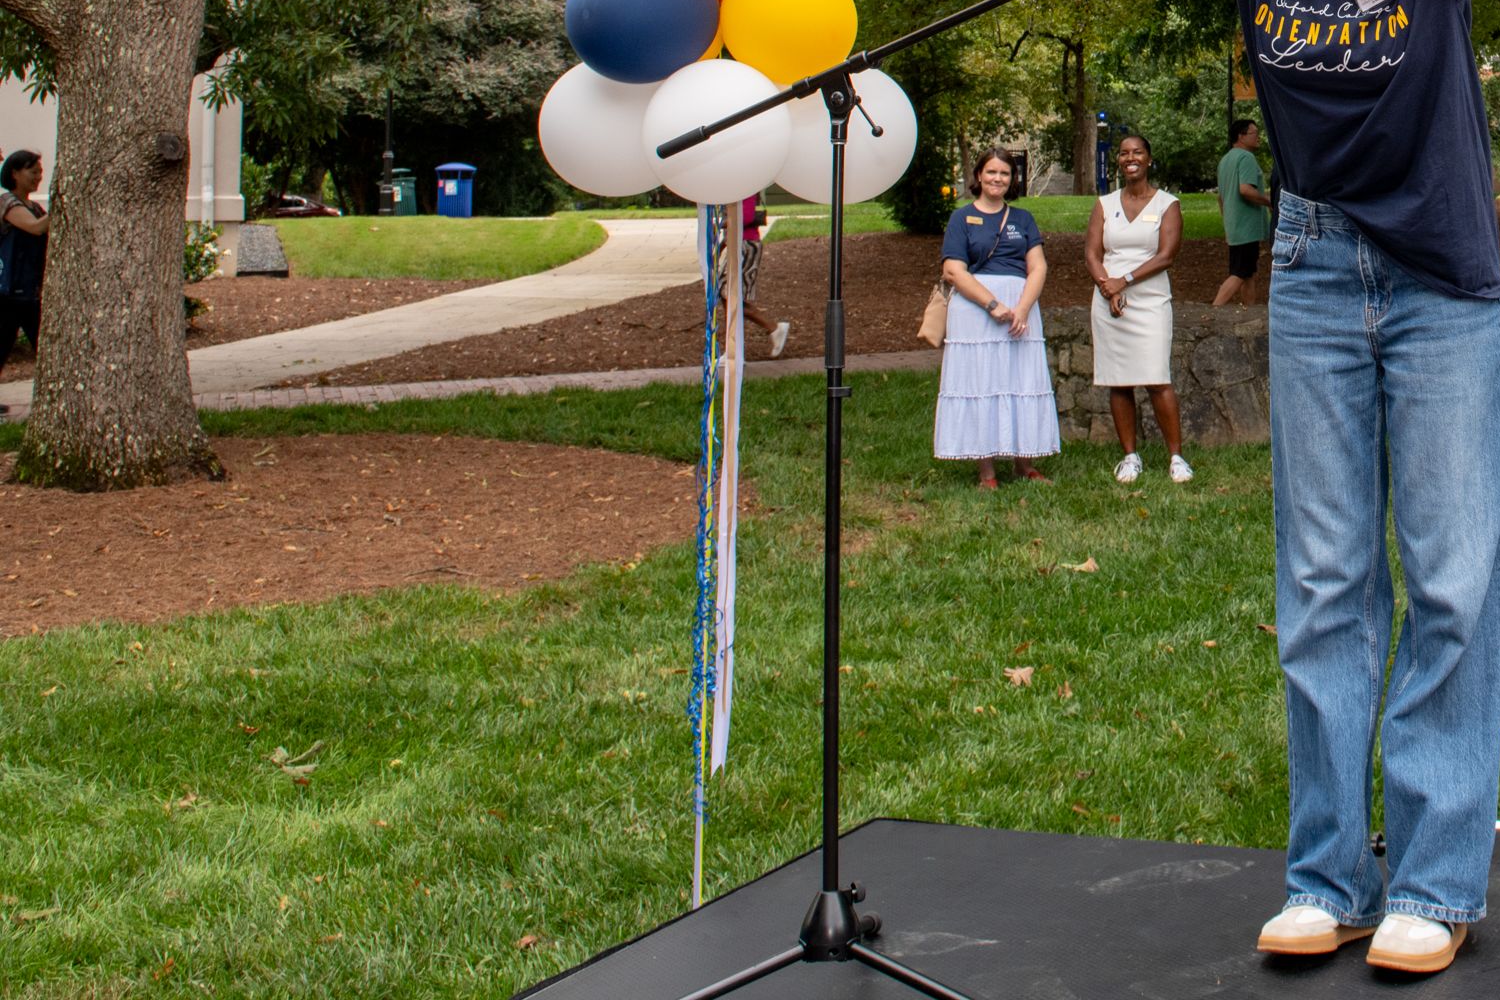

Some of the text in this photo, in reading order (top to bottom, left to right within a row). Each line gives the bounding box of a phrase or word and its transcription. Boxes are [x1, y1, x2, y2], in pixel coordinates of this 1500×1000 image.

[1255, 3, 1409, 46] ORIENTATION
[1337, 2, 1392, 19] Colge
[1258, 35, 1405, 72] Leader
